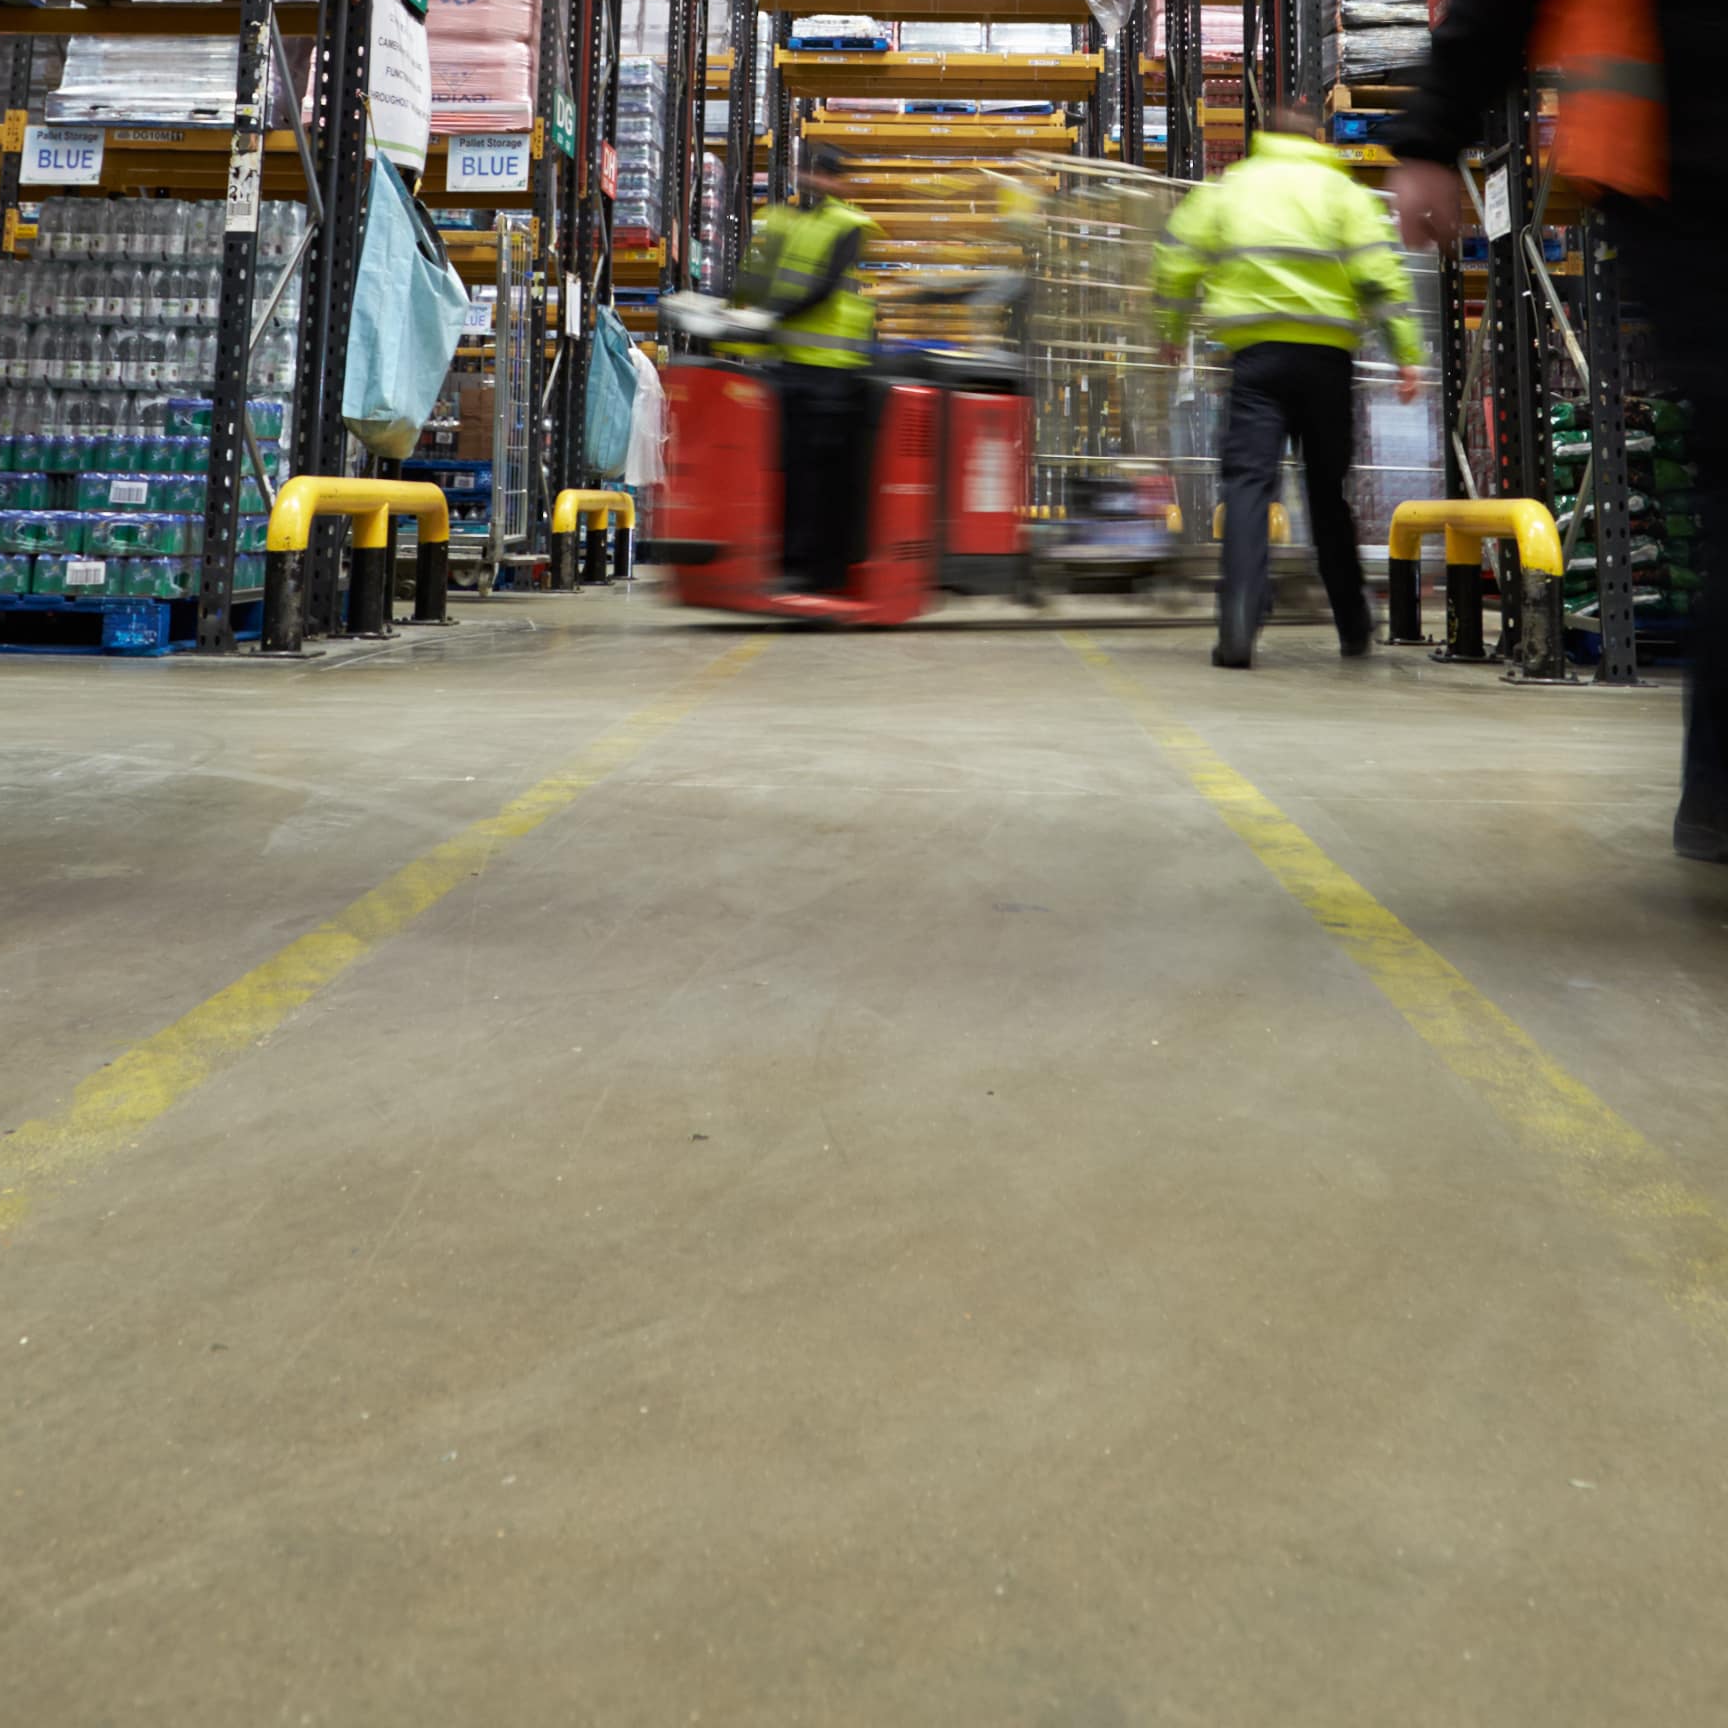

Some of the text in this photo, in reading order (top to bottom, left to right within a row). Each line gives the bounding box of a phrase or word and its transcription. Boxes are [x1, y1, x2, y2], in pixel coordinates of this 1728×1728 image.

[557, 95, 573, 128] DG
[37, 131, 98, 145] Pallet Storage
[459, 138, 522, 153] Pallet Storage
[38, 149, 94, 170] BLUE
[462, 156, 519, 176] BLUE
